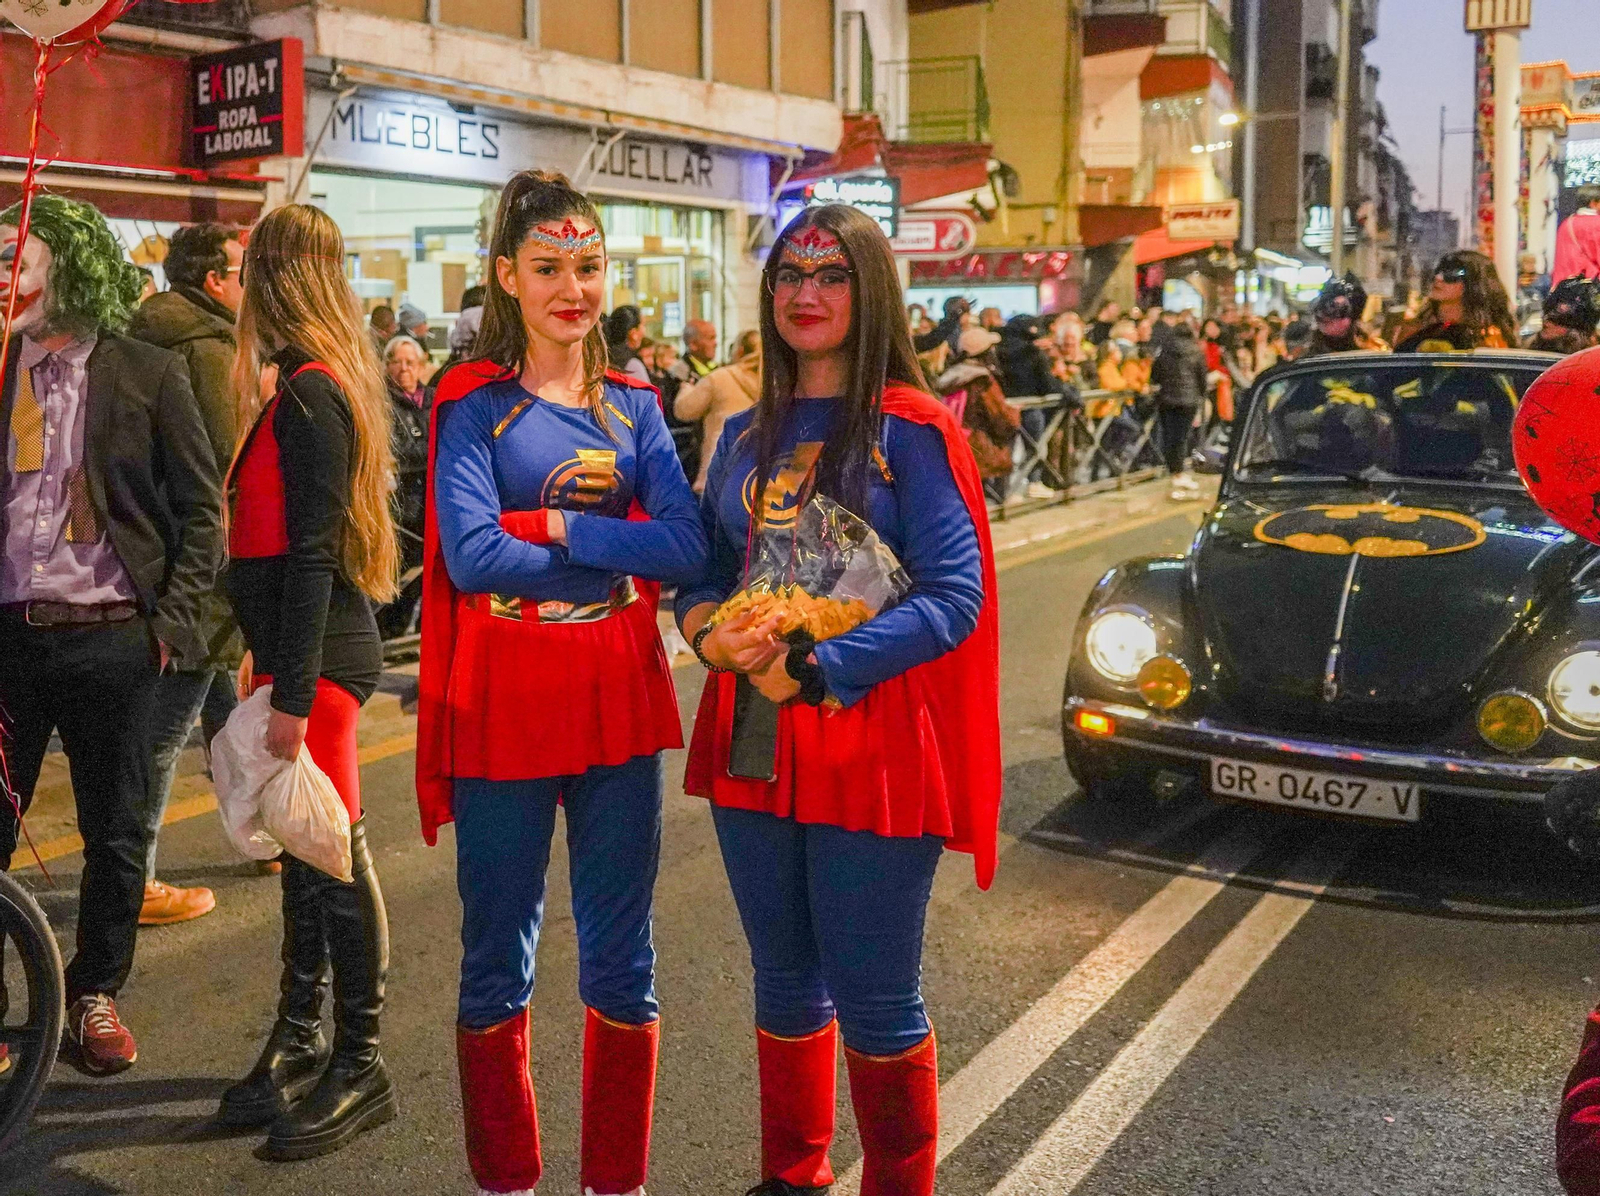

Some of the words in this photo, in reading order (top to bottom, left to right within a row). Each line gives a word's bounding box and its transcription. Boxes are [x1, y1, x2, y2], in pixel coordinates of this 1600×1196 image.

[219, 105, 257, 130] ROPA
[332, 99, 499, 159] MUEBLES
[205, 126, 272, 154] LABORAL
